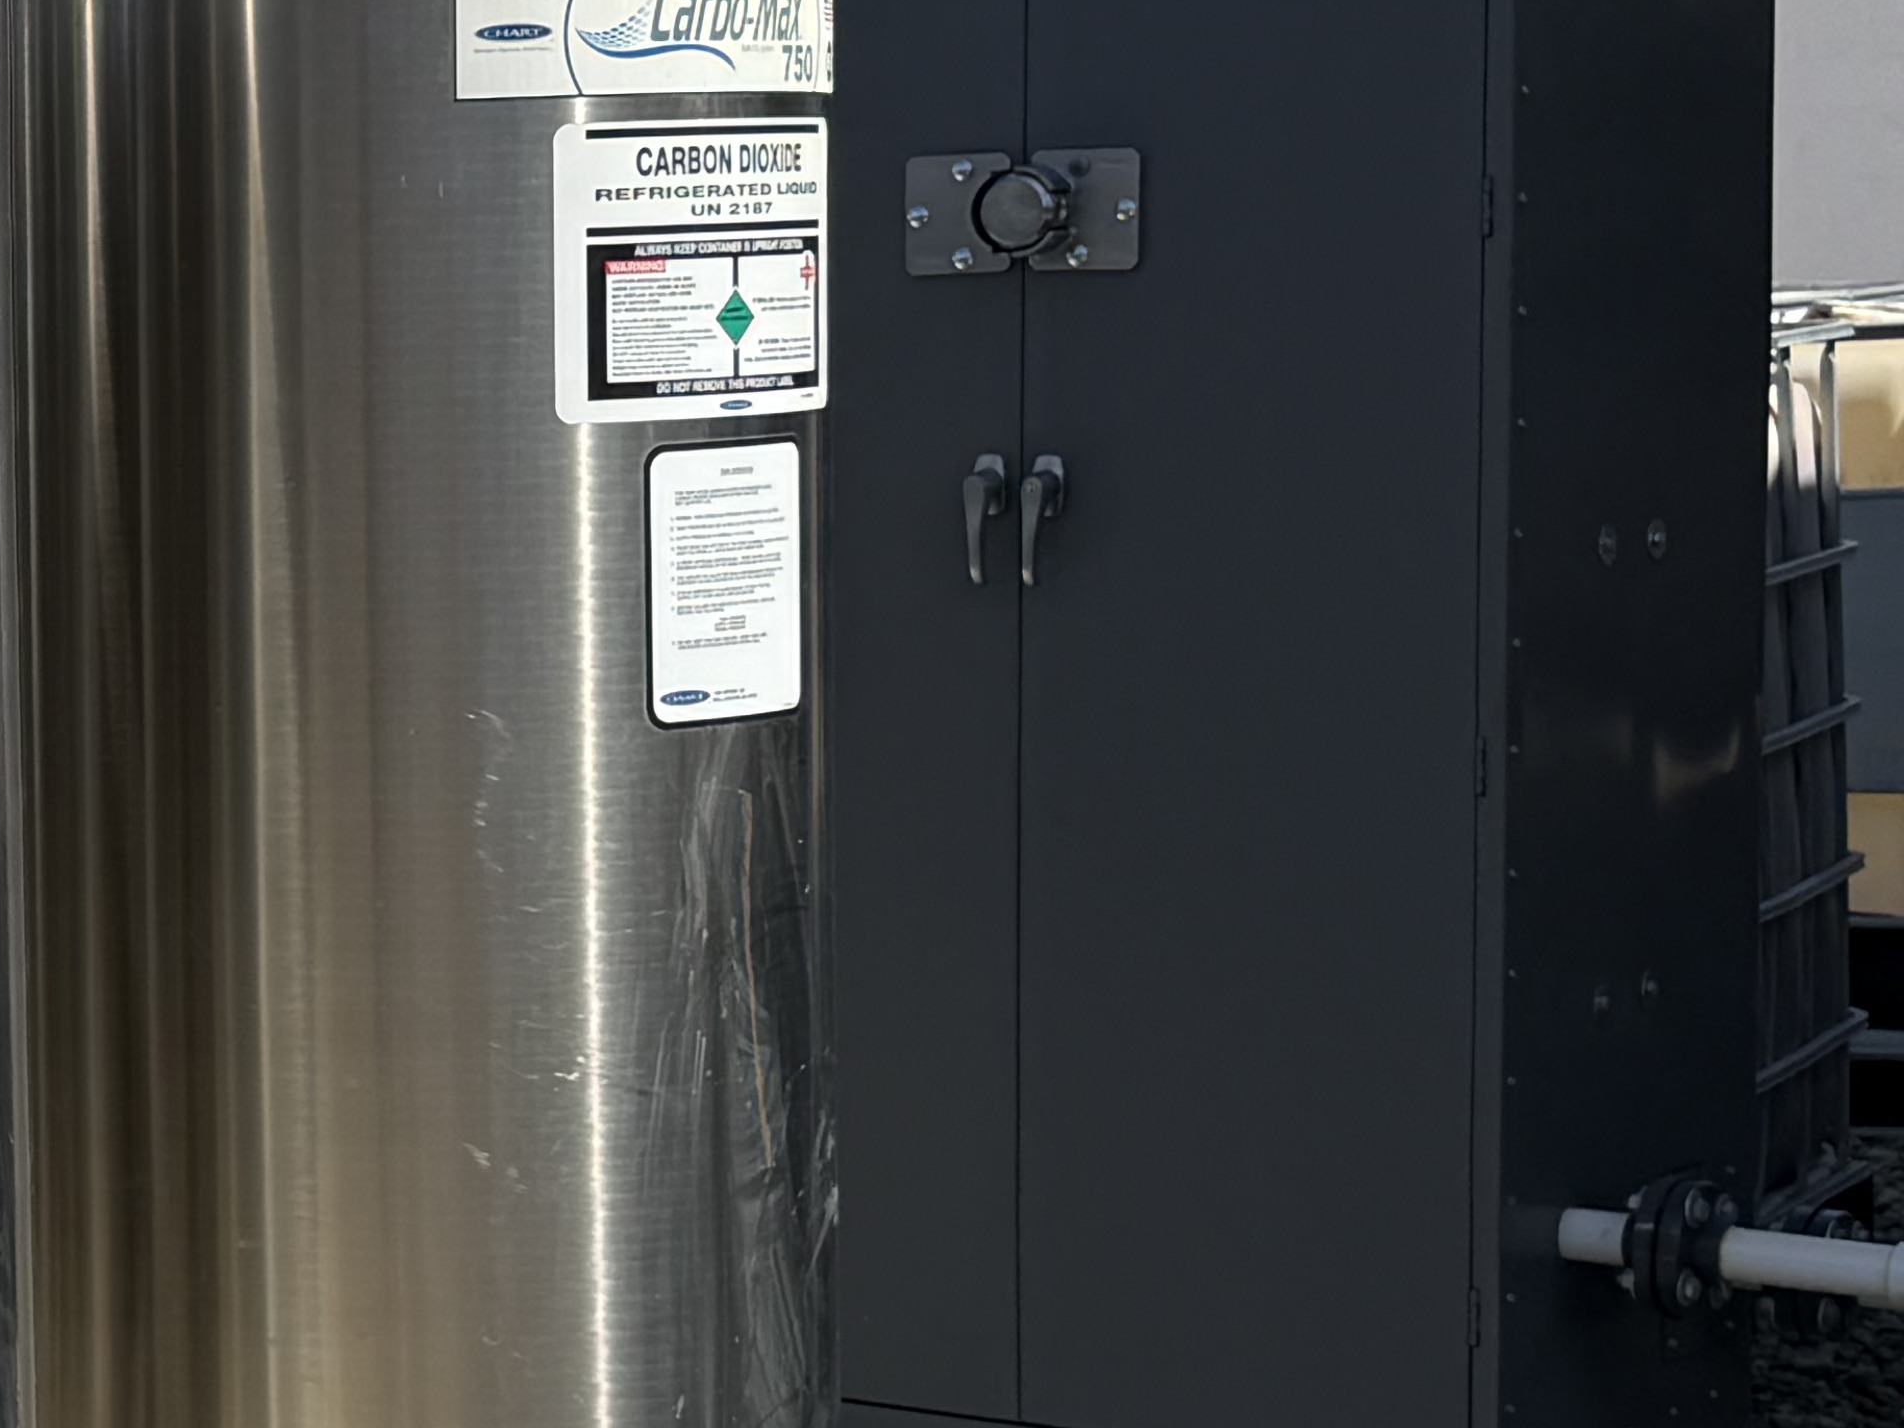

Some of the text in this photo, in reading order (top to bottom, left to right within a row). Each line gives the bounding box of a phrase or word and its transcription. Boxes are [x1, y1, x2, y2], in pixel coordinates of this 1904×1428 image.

[782, 45, 813, 82] 750
[636, 143, 802, 177] CARBON DIOXIDE
[595, 181, 818, 202] REFRIGERATED LIQUID
[691, 202, 773, 216] UN 2187
